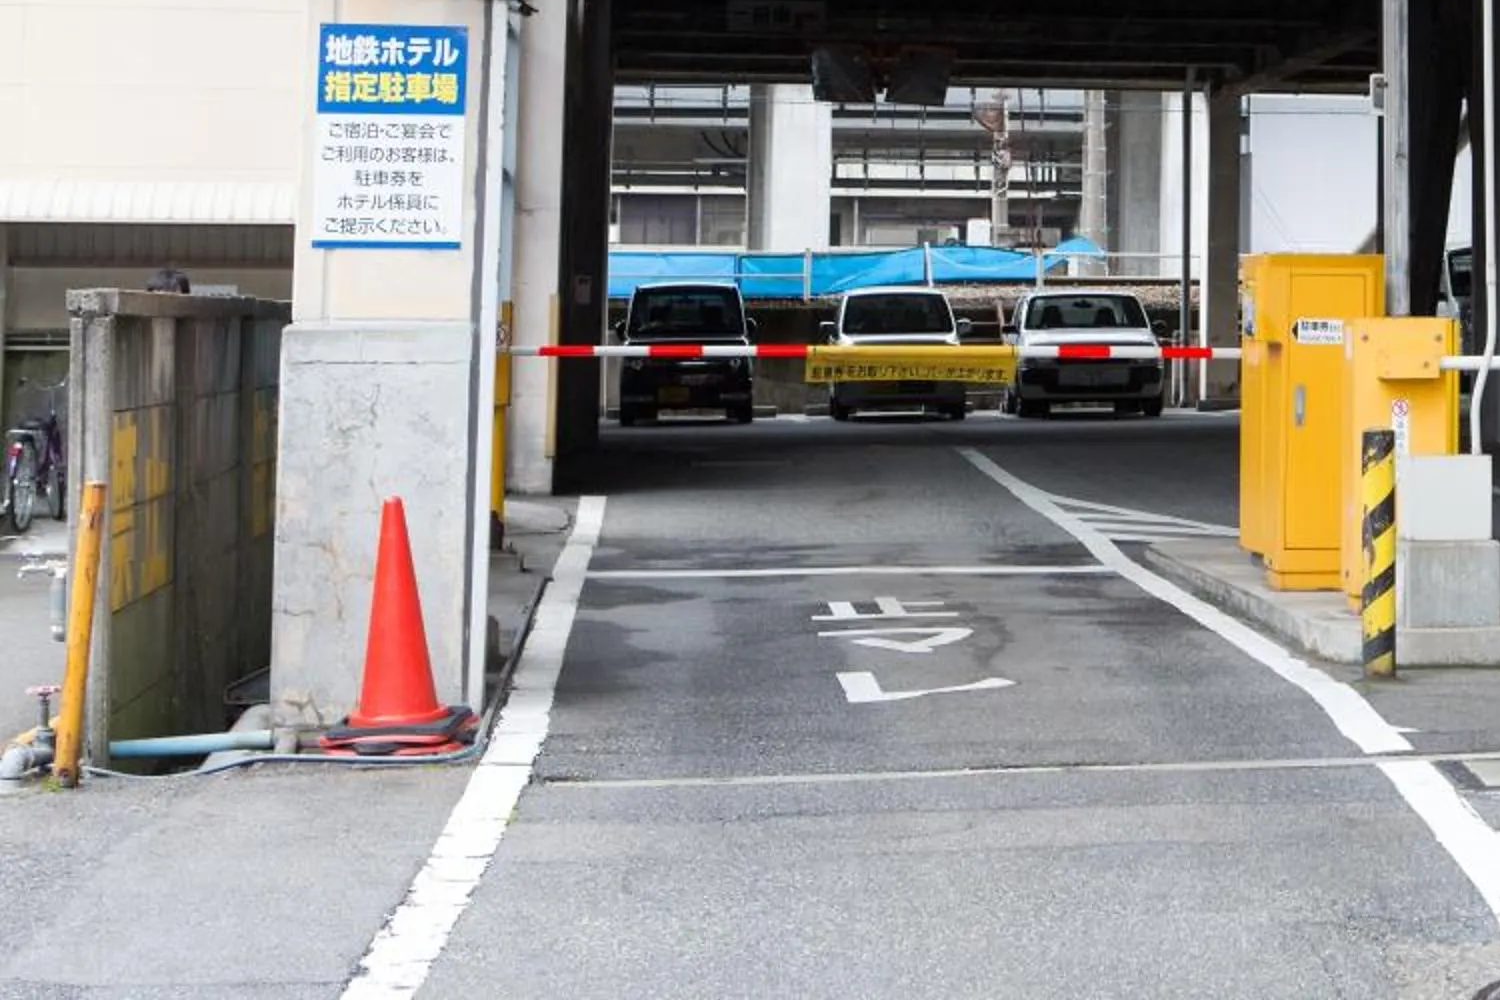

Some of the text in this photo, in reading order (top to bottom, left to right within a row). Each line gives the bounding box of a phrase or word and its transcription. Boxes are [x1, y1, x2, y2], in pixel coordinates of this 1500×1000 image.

[325, 34, 459, 67] 地鉄ホテル
[324, 71, 459, 104] 指定駐車場
[355, 170, 424, 187] 駐車券を
[337, 193, 440, 211] ホテル係員に
[324, 217, 448, 235] ご提示ください。
